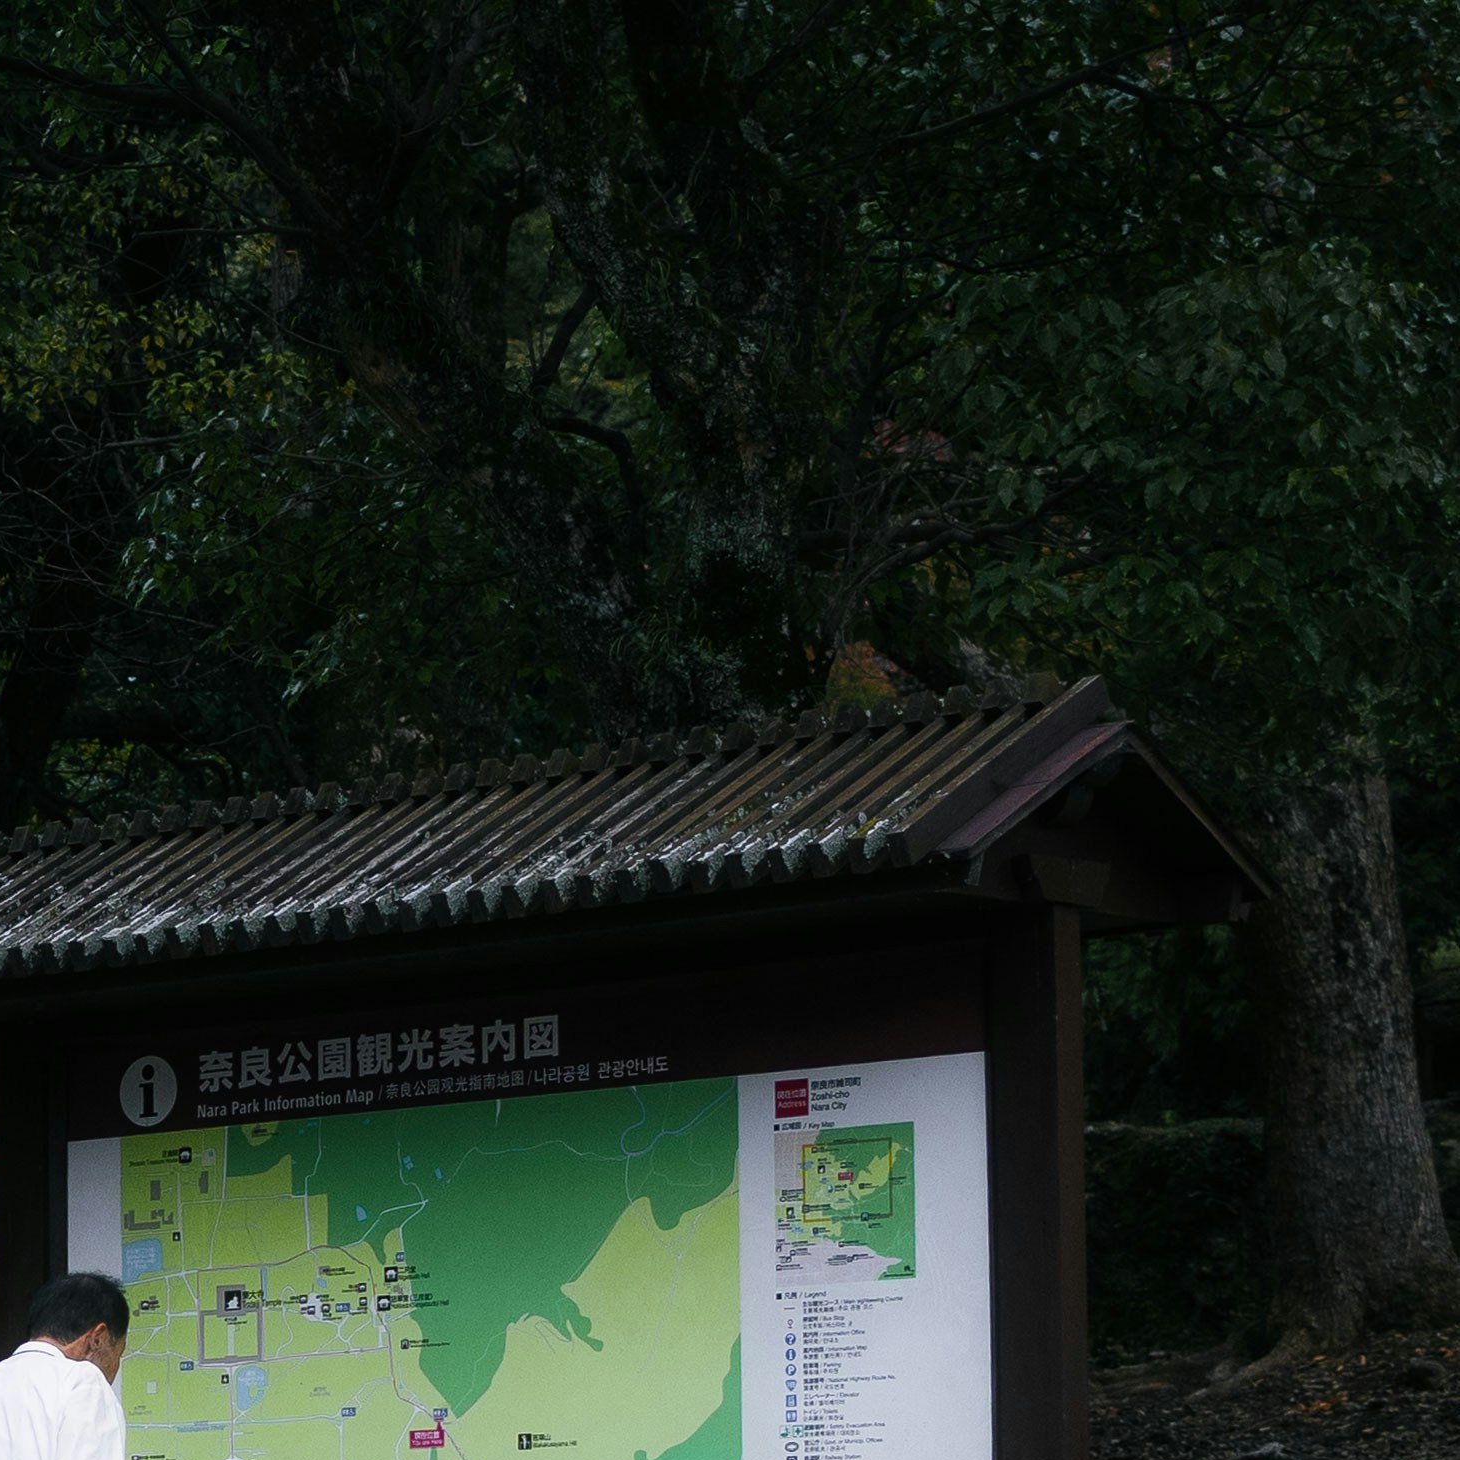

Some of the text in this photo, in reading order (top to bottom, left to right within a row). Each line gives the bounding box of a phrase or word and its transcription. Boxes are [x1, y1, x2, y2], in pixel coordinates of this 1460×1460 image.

[199, 1015, 559, 1093] 奈良公園観光案内図
[385, 1070, 524, 1099] 奈良公园观光指南地图
[534, 1056, 669, 1086] 나라공원 관광안내도
[197, 1088, 374, 1118] Nara Park Information Map
[777, 1100, 807, 1109] Address
[811, 1090, 850, 1102] Zoshi-cho
[811, 1101, 848, 1112] Nara City
